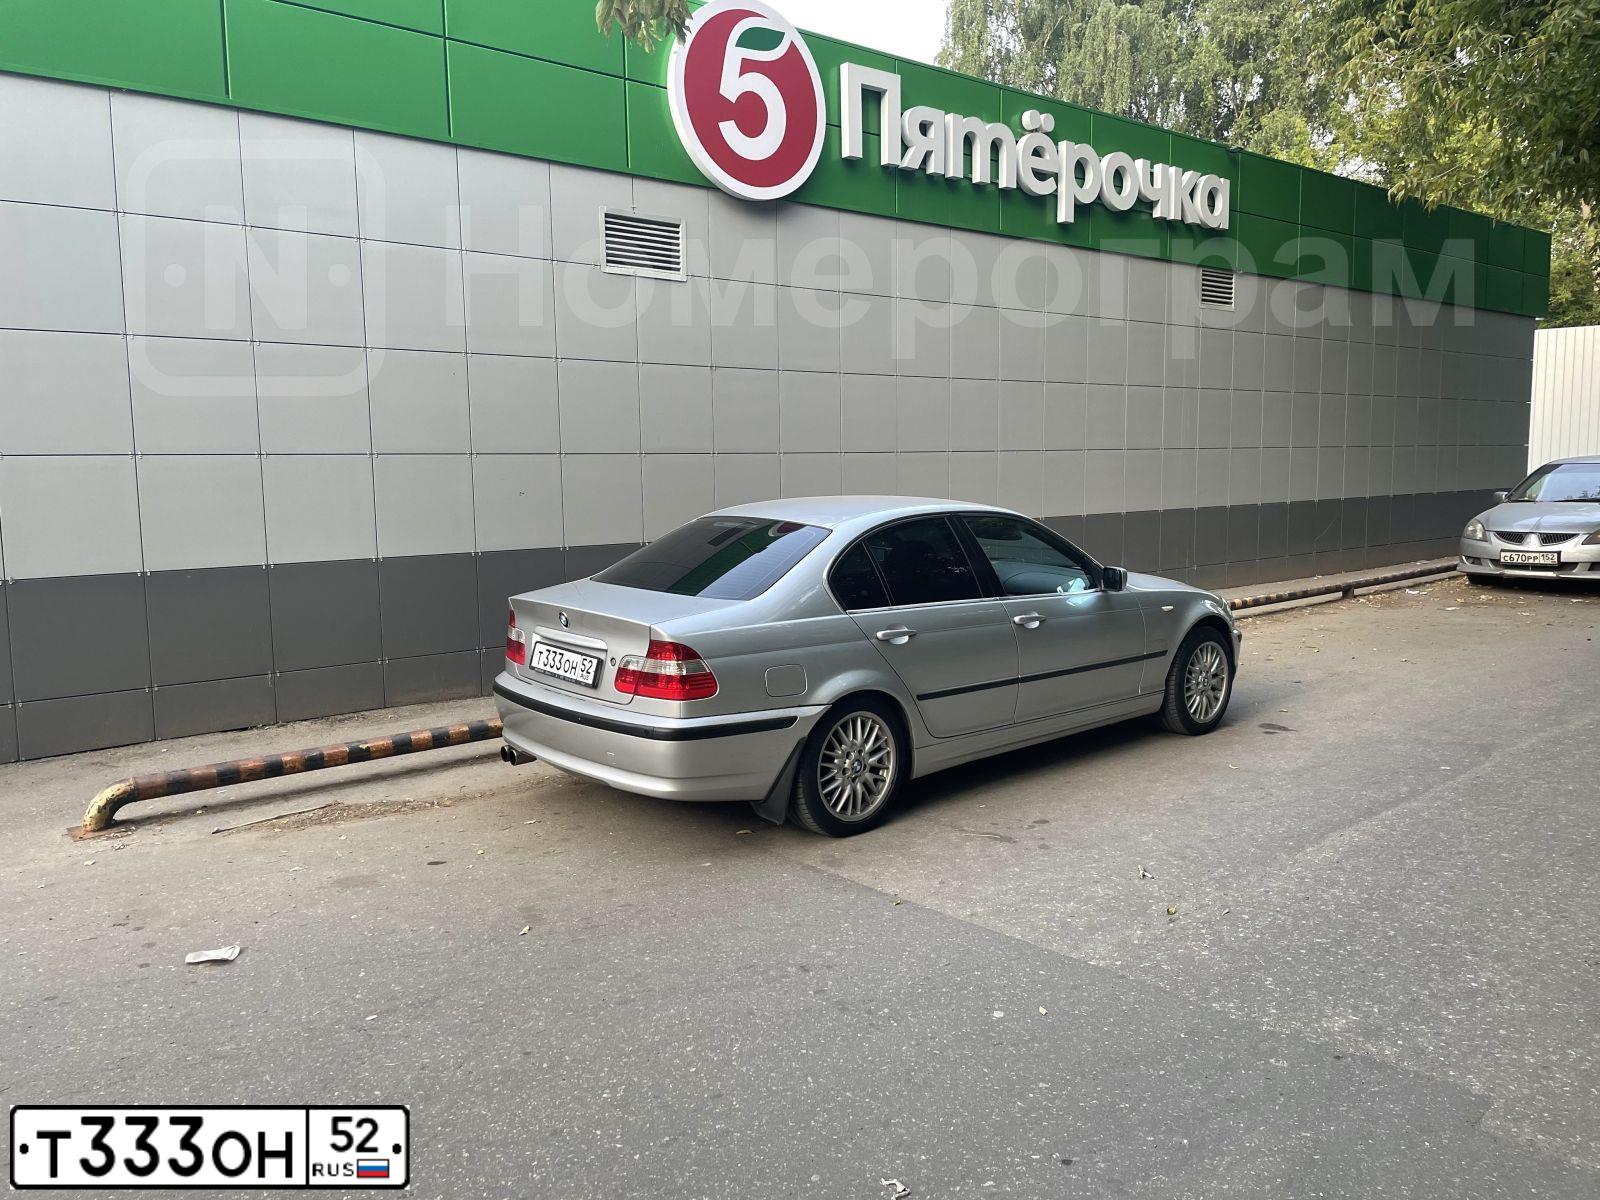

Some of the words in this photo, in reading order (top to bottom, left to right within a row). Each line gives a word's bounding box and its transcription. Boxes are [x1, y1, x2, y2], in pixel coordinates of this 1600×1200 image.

[718, 17, 797, 161] 5
[840, 62, 1231, 230] Пятёрочка
[1503, 553, 1538, 562] С670РР
[1541, 553, 1555, 561] 152
[538, 649, 578, 676] Т333ОН
[580, 658, 593, 674] 52
